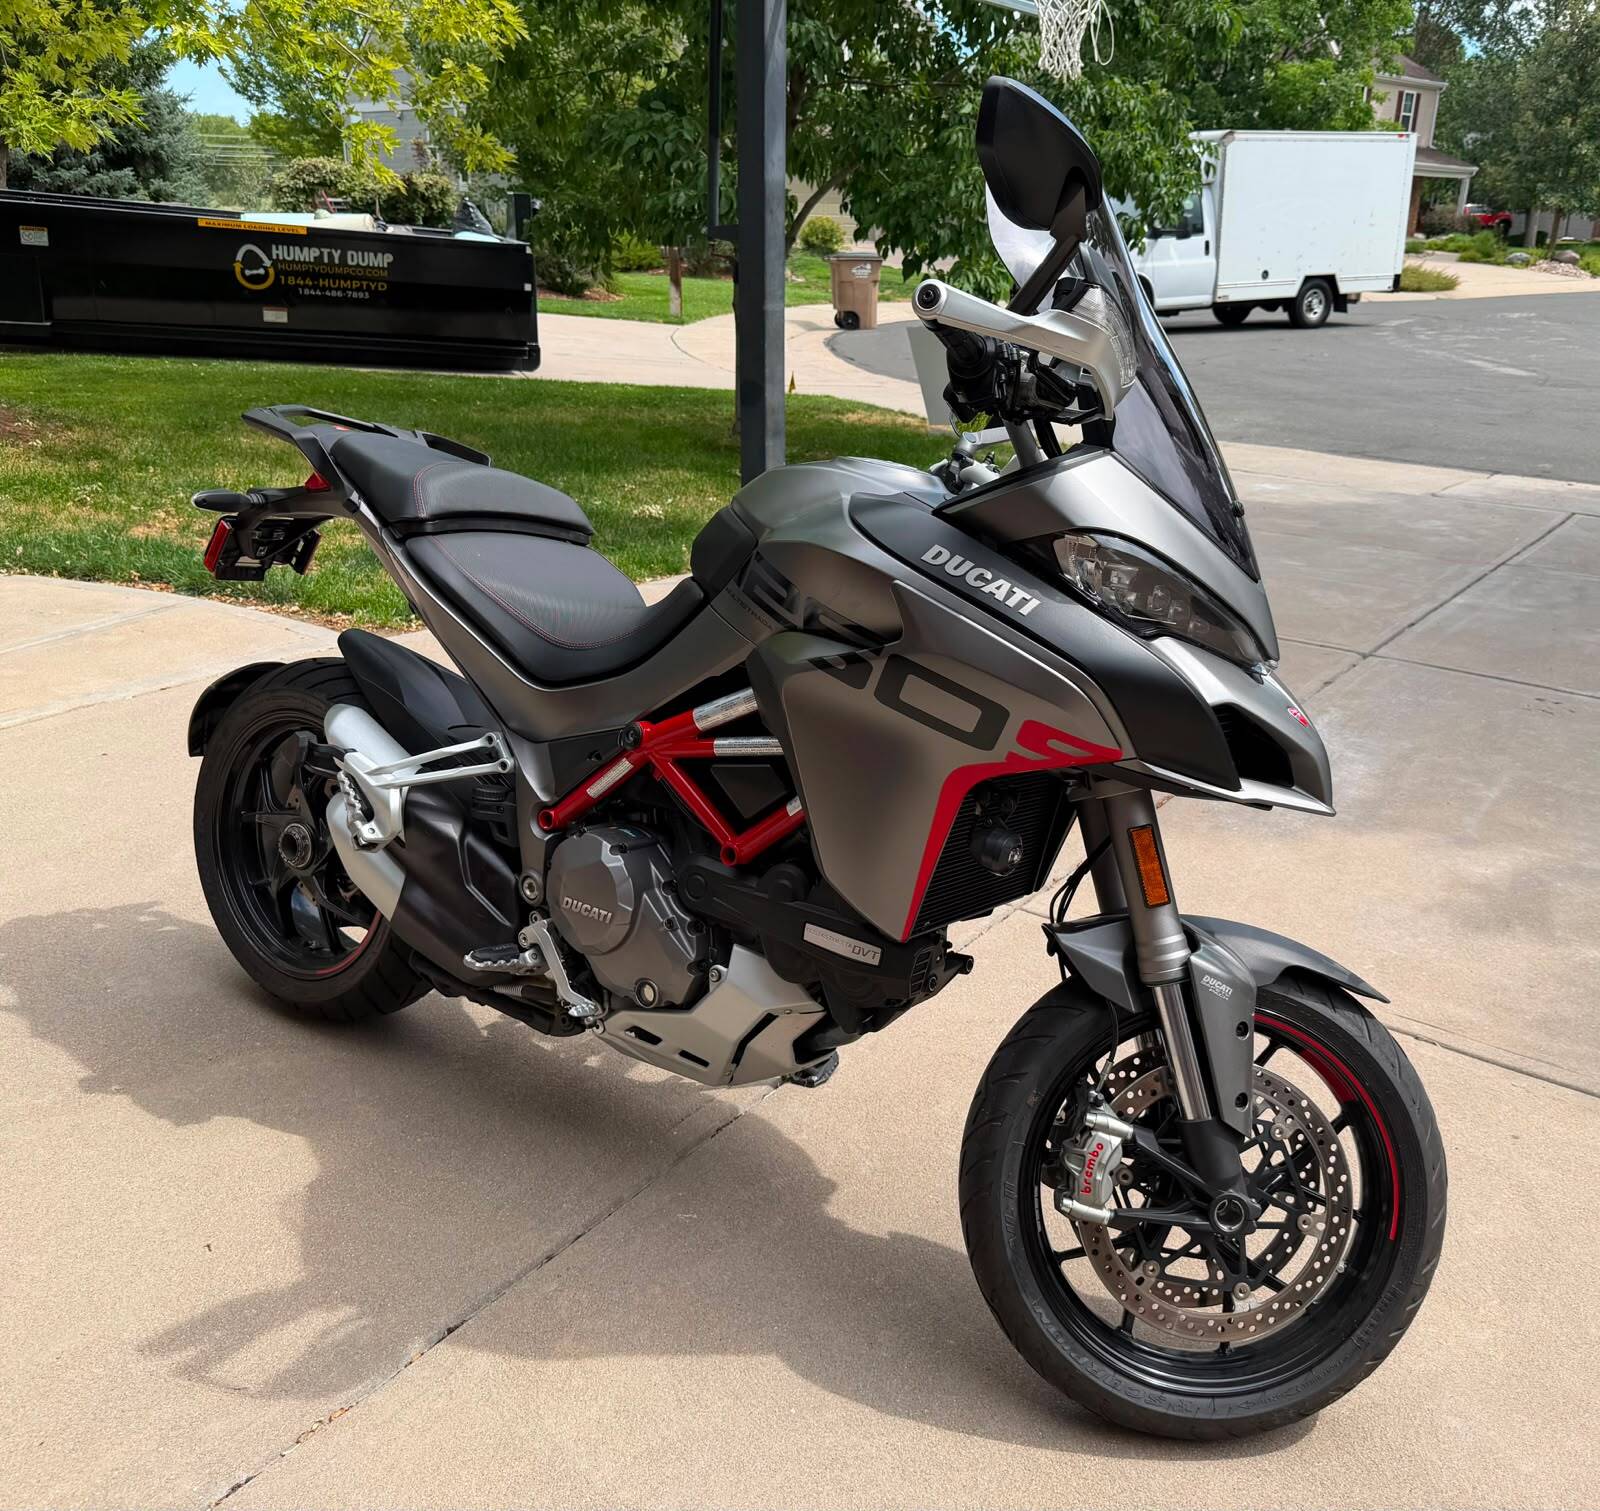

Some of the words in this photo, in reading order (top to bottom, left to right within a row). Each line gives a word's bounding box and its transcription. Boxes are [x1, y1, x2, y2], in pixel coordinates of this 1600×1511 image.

[205, 220, 243, 229] MAXIMUM
[271, 244, 341, 264] HUMPTY
[347, 250, 394, 268] DUMP
[278, 262, 389, 277] HUMPTYDUMPCO.COM
[920, 544, 1041, 616] DUCATI
[562, 896, 612, 924] DUCATI
[851, 944, 880, 960] DVT
[1202, 974, 1233, 995] DUCATI
[1080, 1142, 1104, 1195] brembo
